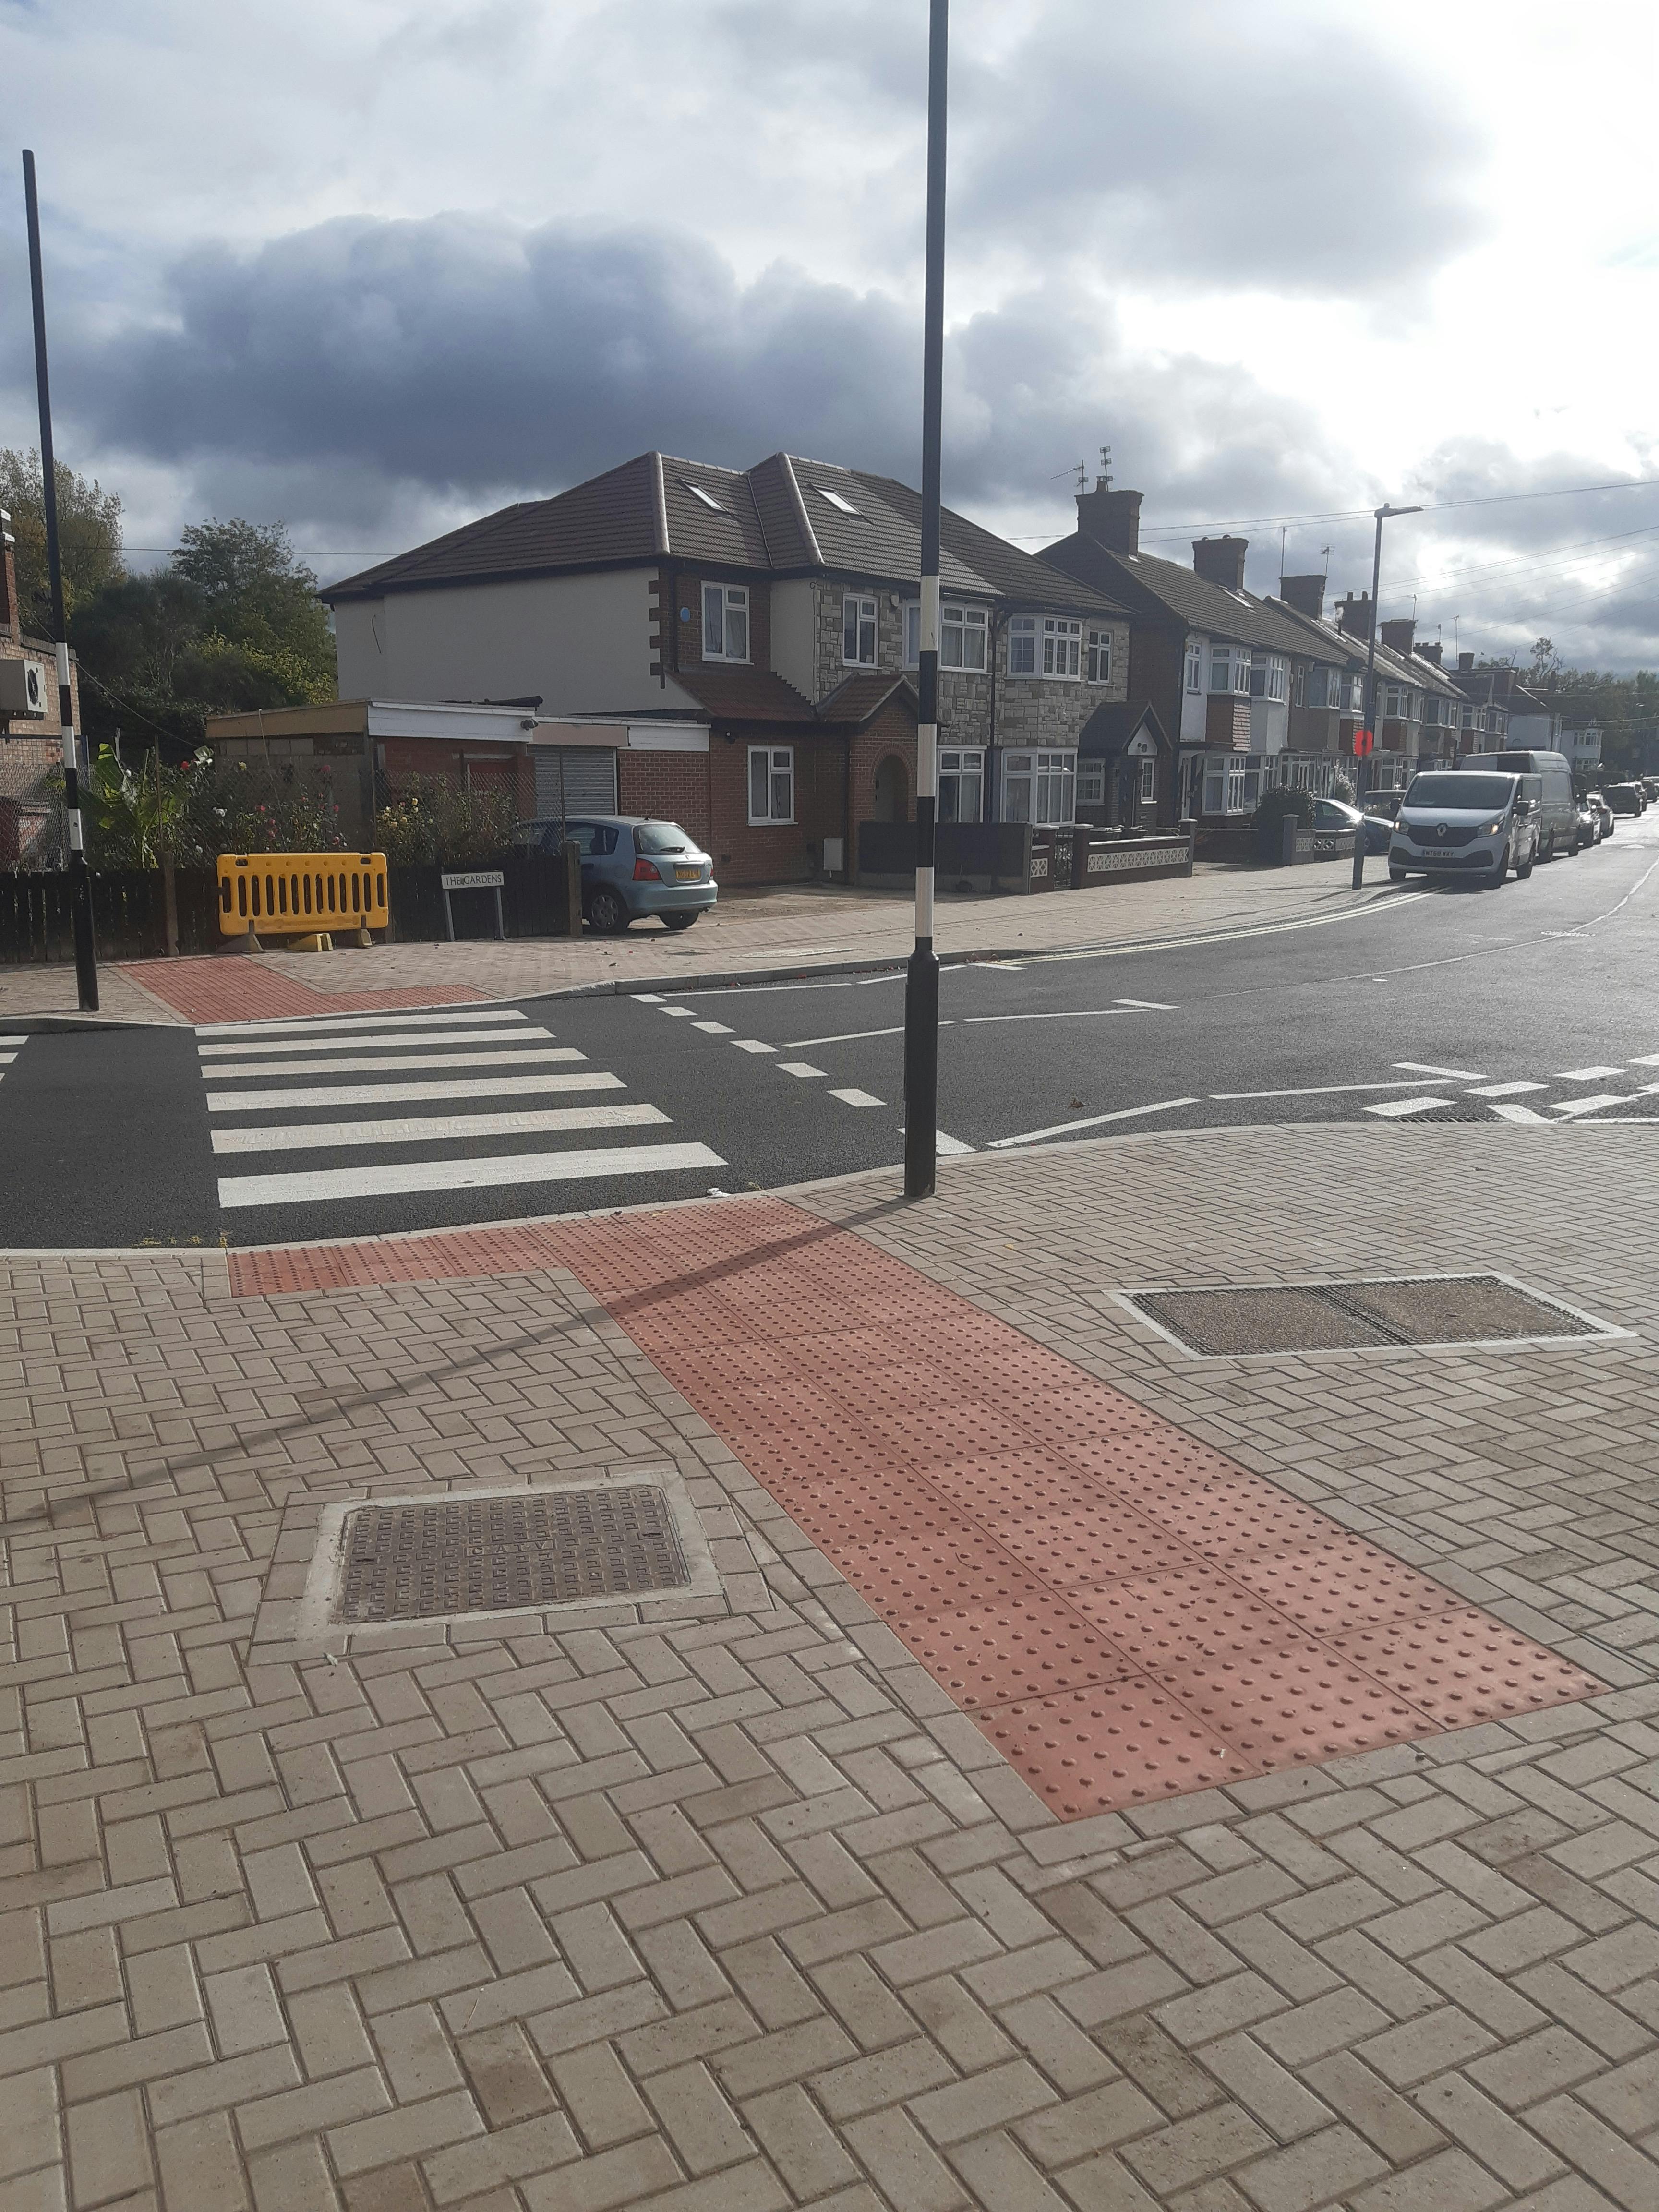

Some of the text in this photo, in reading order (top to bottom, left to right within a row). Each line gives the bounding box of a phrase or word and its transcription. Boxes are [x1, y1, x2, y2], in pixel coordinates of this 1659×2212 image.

[445, 875, 501, 886] THE GARDENS
[472, 1541, 546, 1555] CATV
